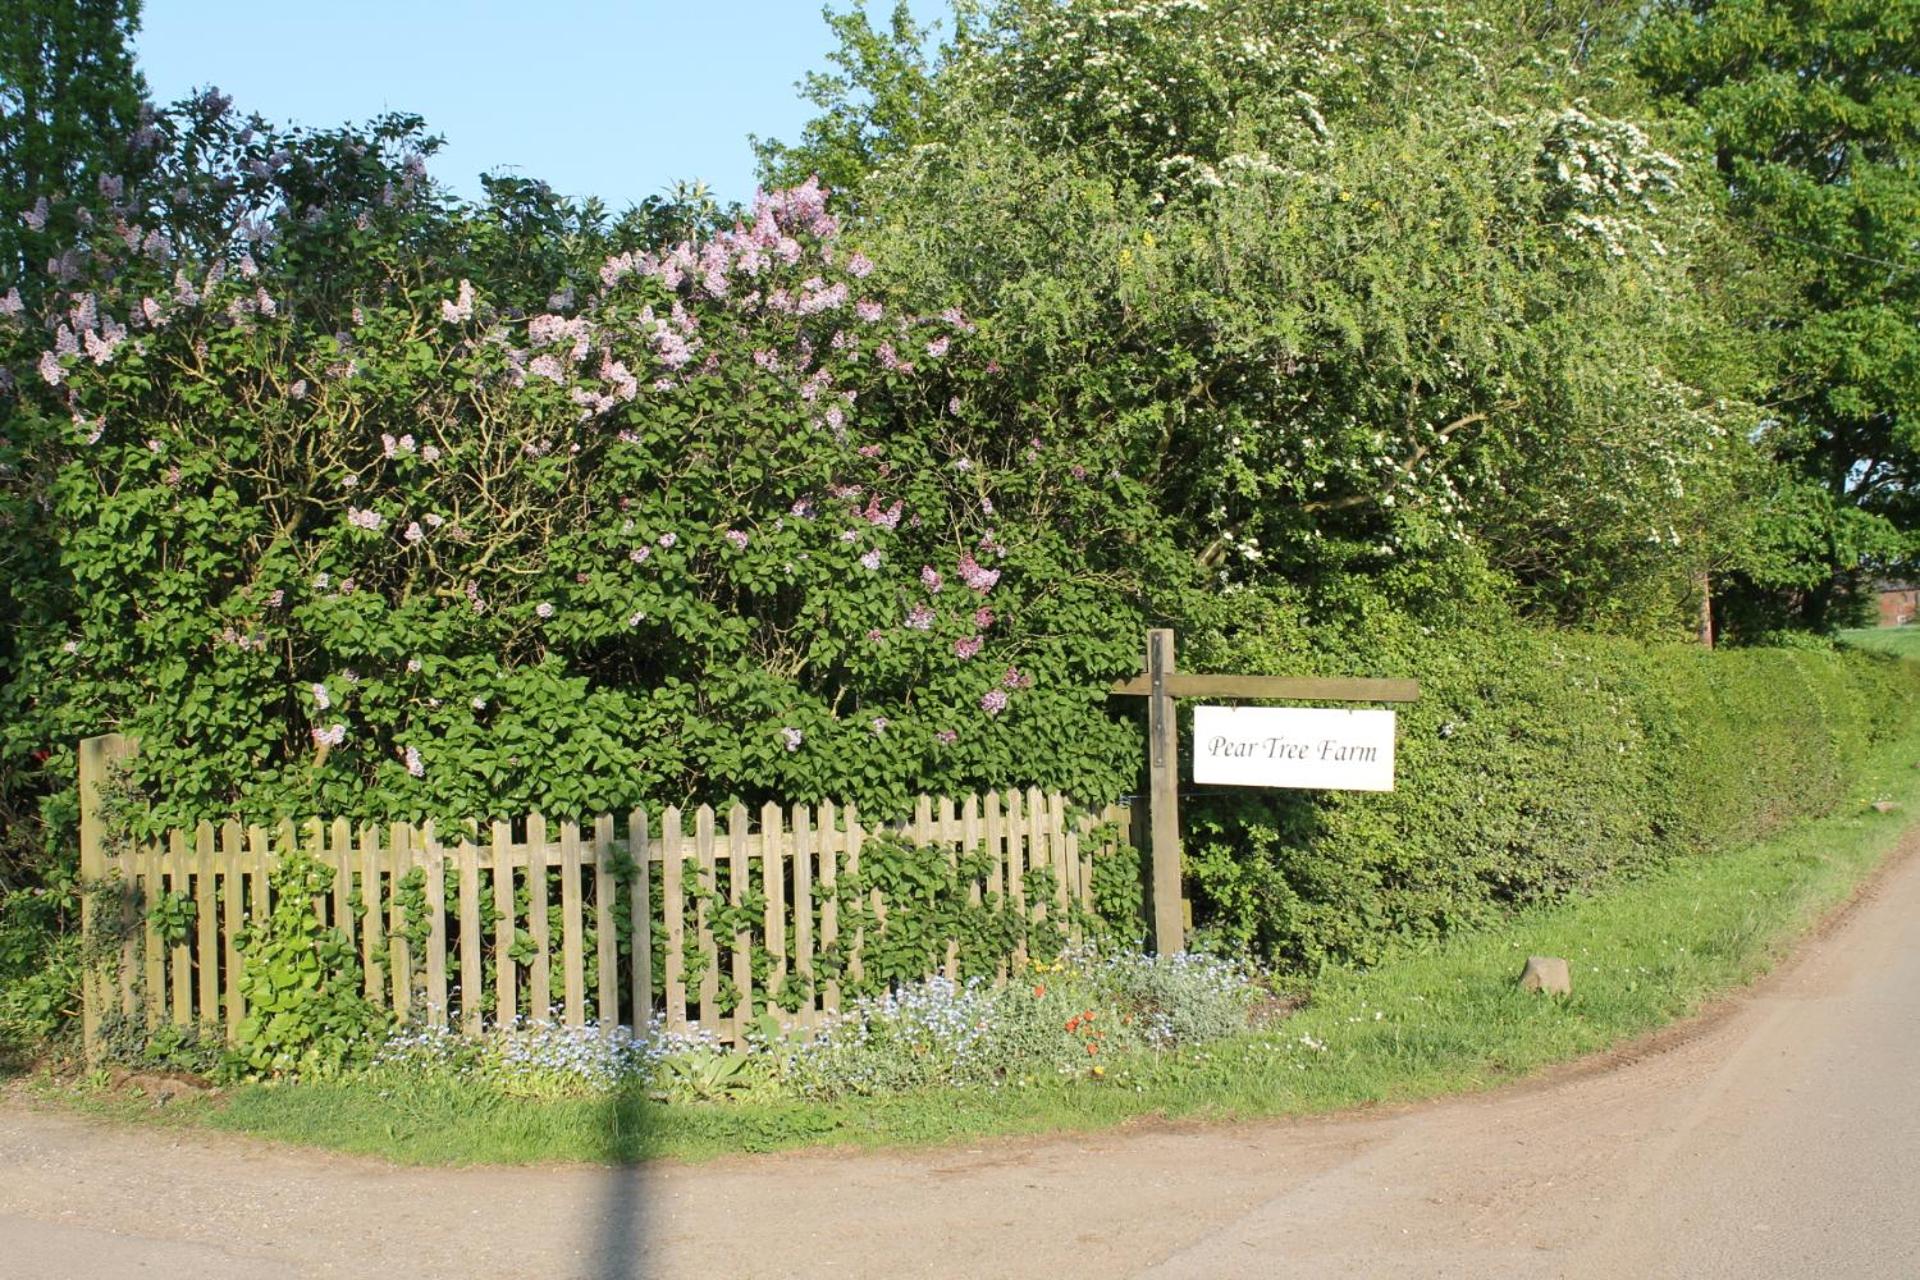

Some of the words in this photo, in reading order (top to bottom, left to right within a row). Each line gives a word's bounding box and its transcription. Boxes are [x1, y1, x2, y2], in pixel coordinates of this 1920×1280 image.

[1208, 736, 1258, 757] Pear
[1263, 737, 1309, 759] Tree
[1317, 740, 1377, 761] Farm
